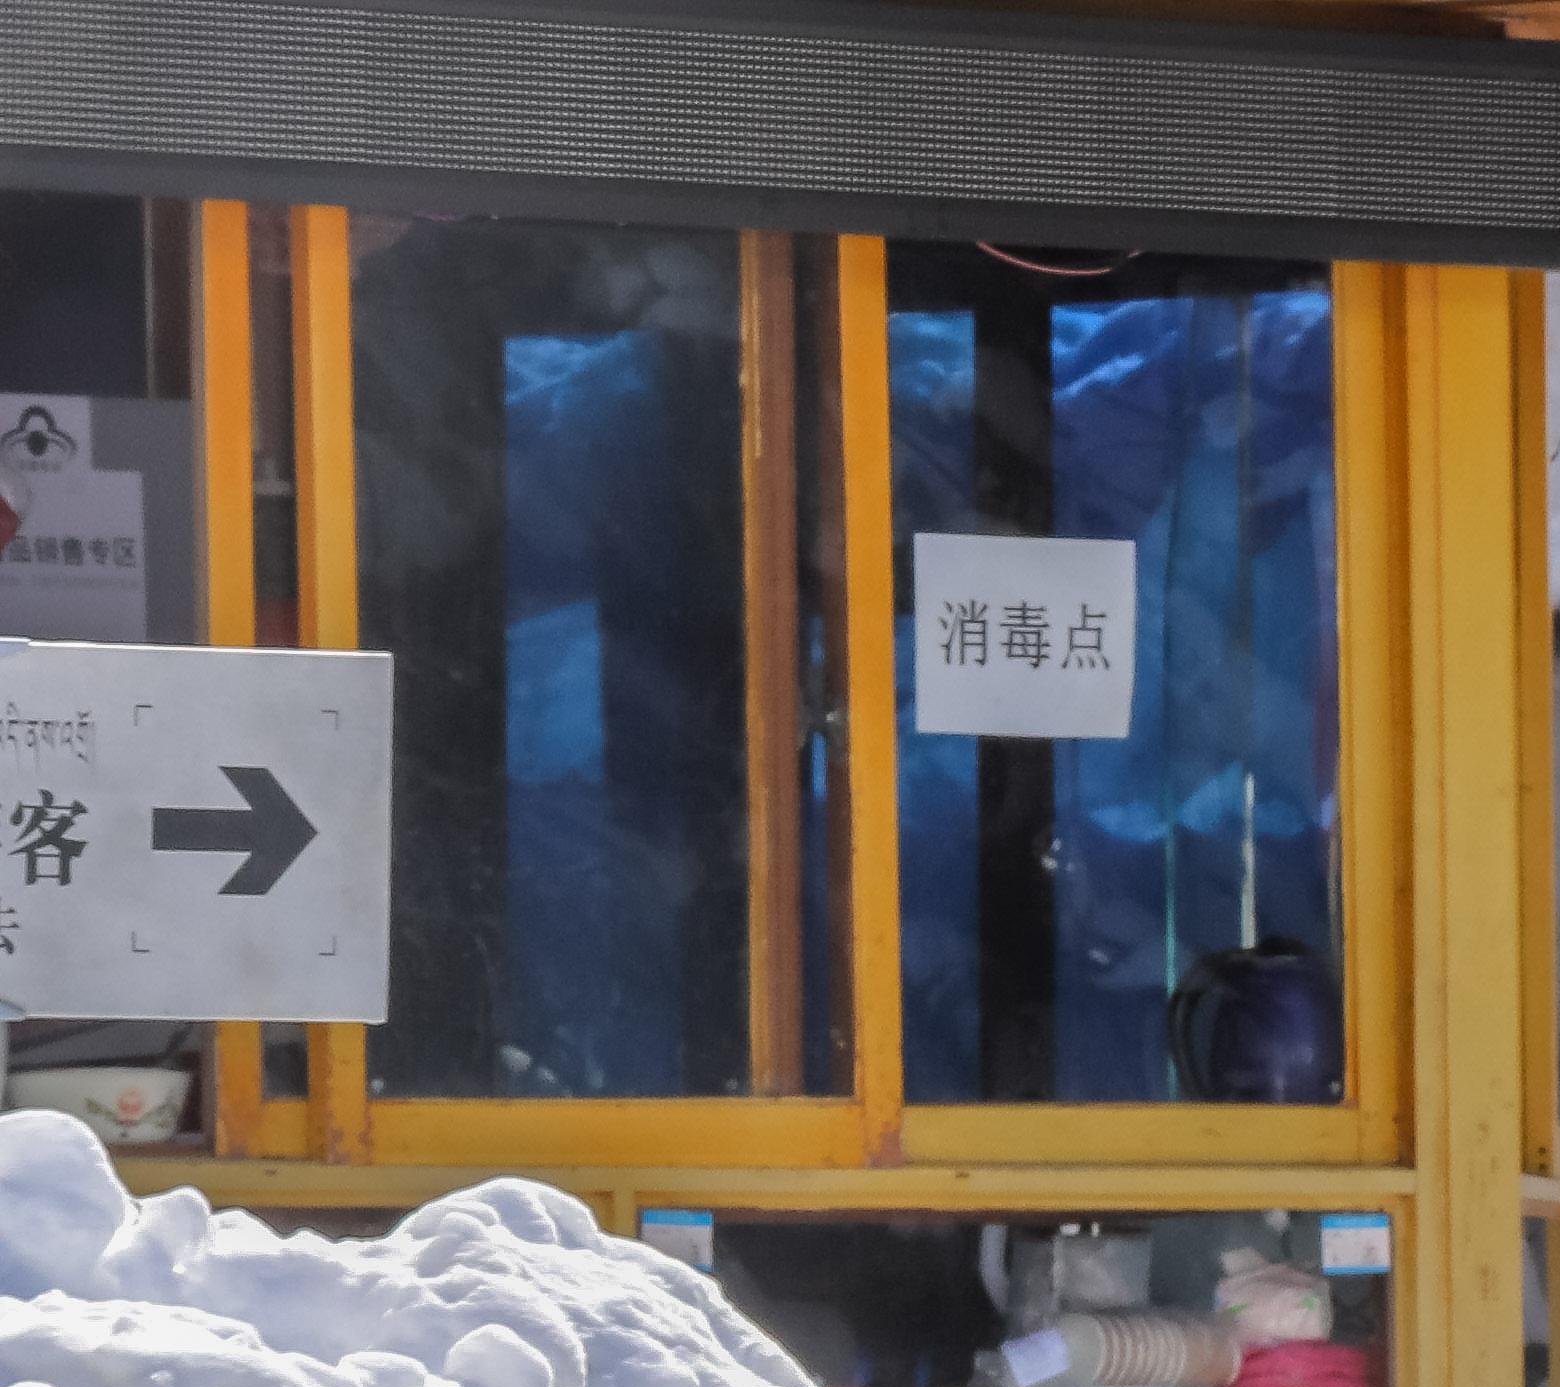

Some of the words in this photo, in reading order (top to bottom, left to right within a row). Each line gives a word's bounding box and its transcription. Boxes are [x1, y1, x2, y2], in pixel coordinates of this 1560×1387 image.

[0, 536, 136, 567] 品销售专区
[939, 599, 1111, 670] 消毒点
[0, 788, 89, 887] 客
